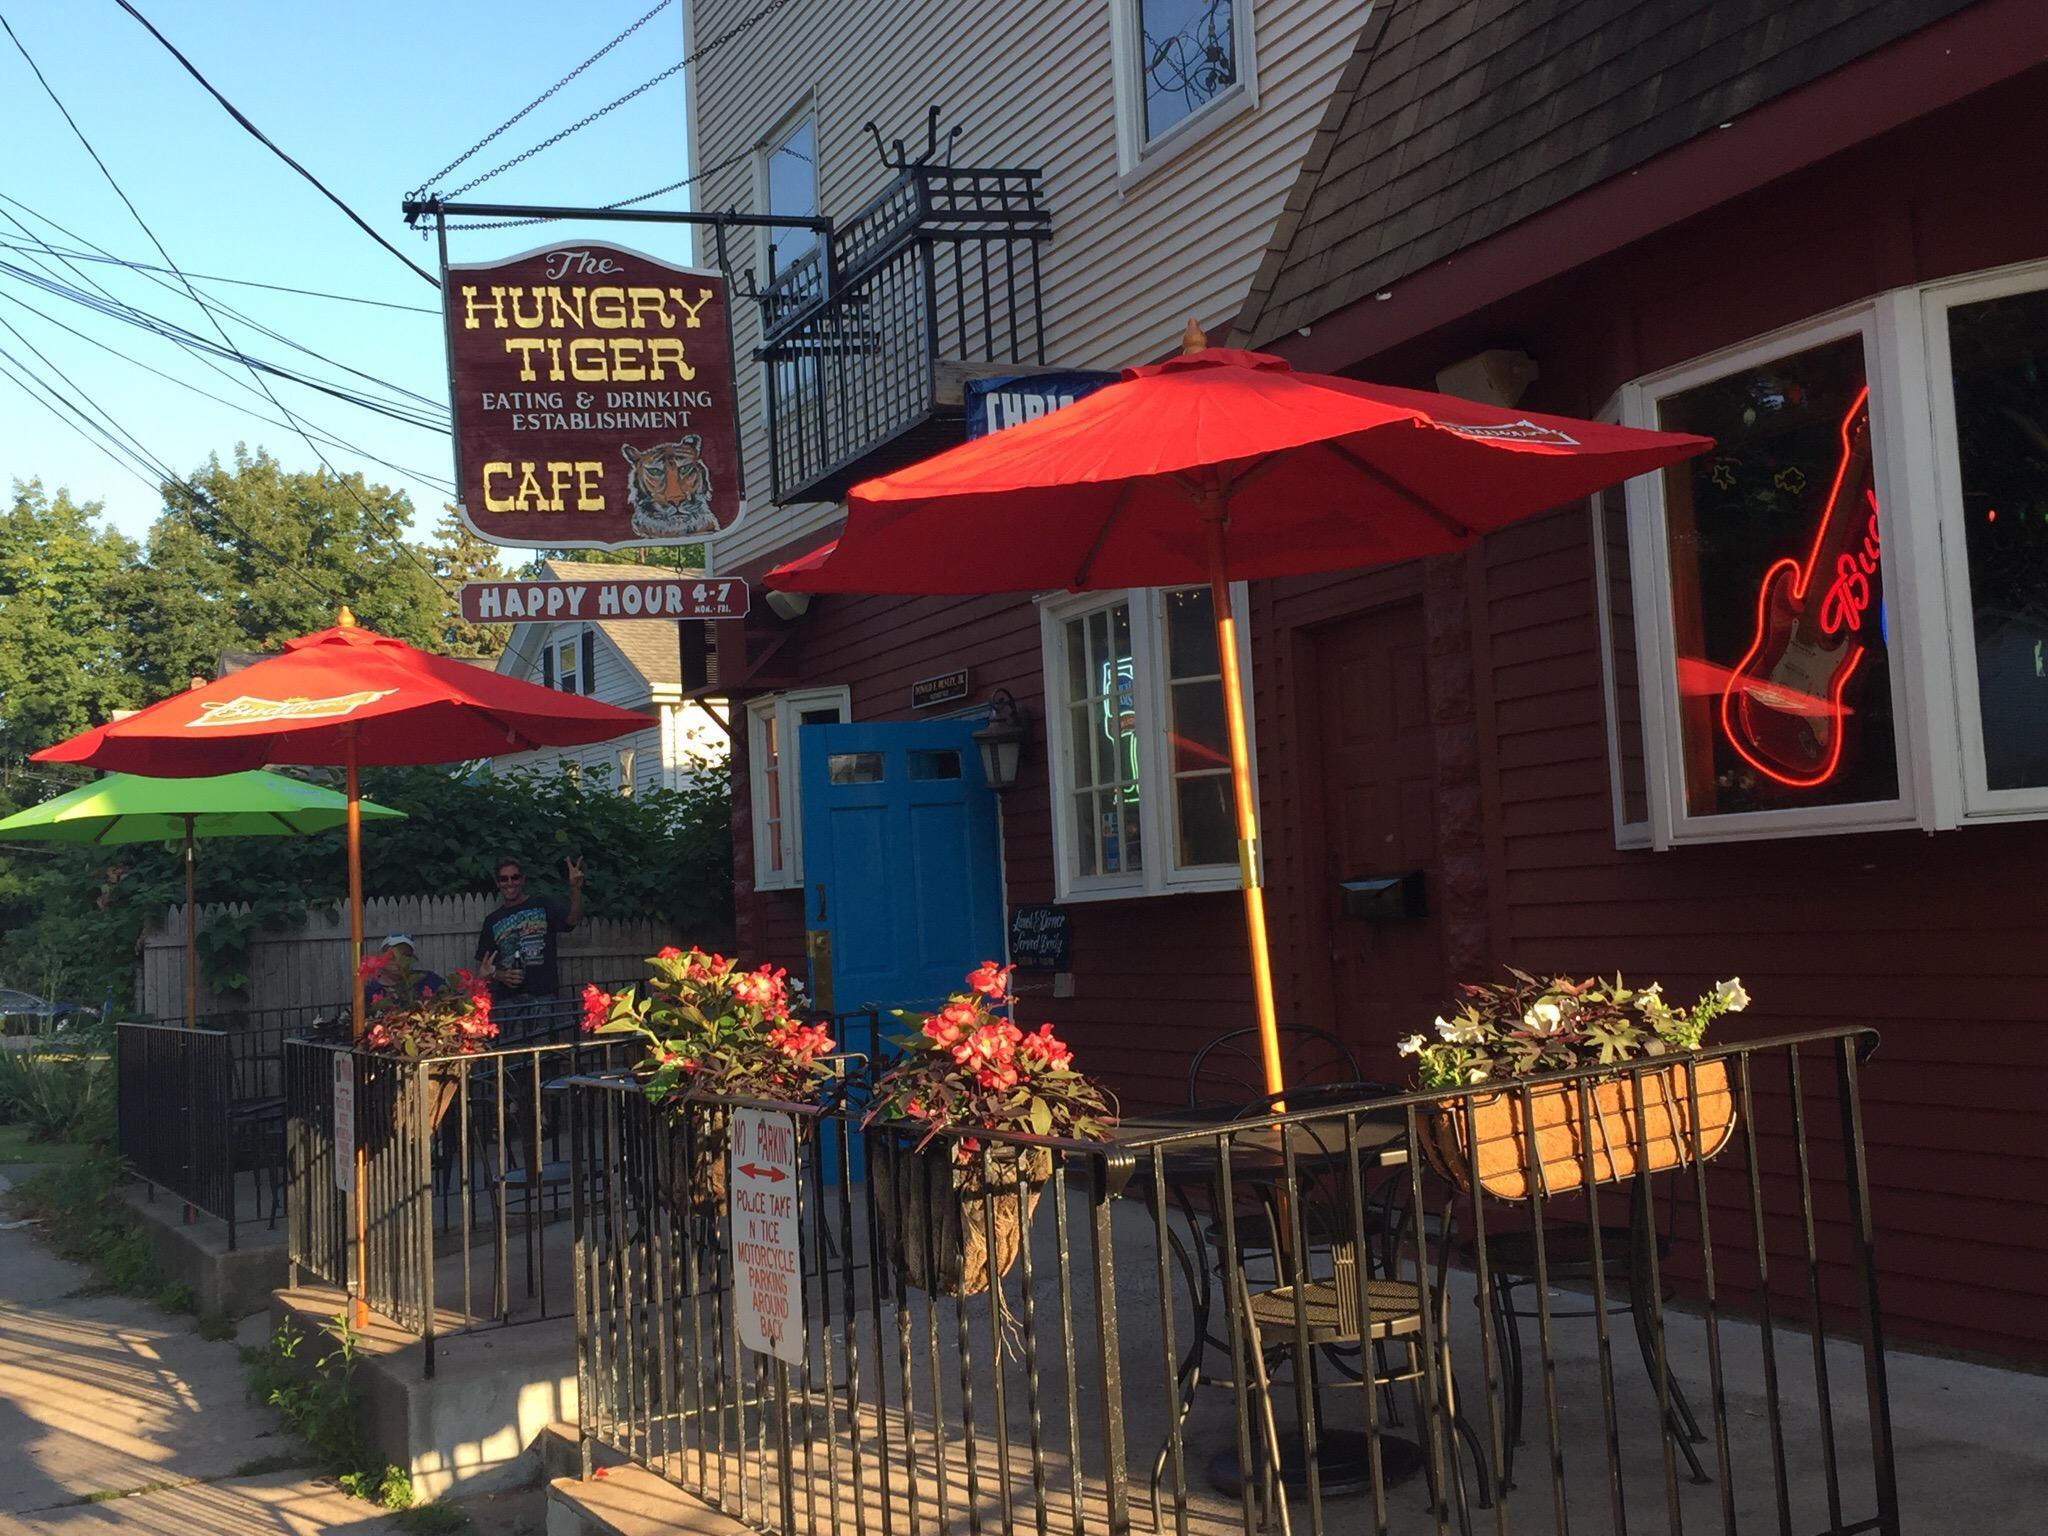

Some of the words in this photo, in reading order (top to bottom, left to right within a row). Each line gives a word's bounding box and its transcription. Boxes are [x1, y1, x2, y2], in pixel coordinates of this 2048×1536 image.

[546, 250, 625, 280] The
[462, 286, 714, 330] HUNGRY
[505, 337, 696, 382] TIGER
[482, 391, 564, 411] EATING
[575, 393, 595, 409] &
[607, 390, 713, 408] DRINKING
[986, 392, 1074, 436] CHR
[512, 410, 692, 431] ESTABLISHMENT
[482, 461, 606, 513] CAFE
[480, 586, 587, 618] HAPPY
[598, 584, 684, 615] HOUR
[692, 582, 731, 602] 4-7
[734, 1119, 746, 1157] NO
[738, 1241, 796, 1274] MOTORCYCLE
[752, 1290, 789, 1320] AROUND
[760, 1315, 785, 1343] BACK
